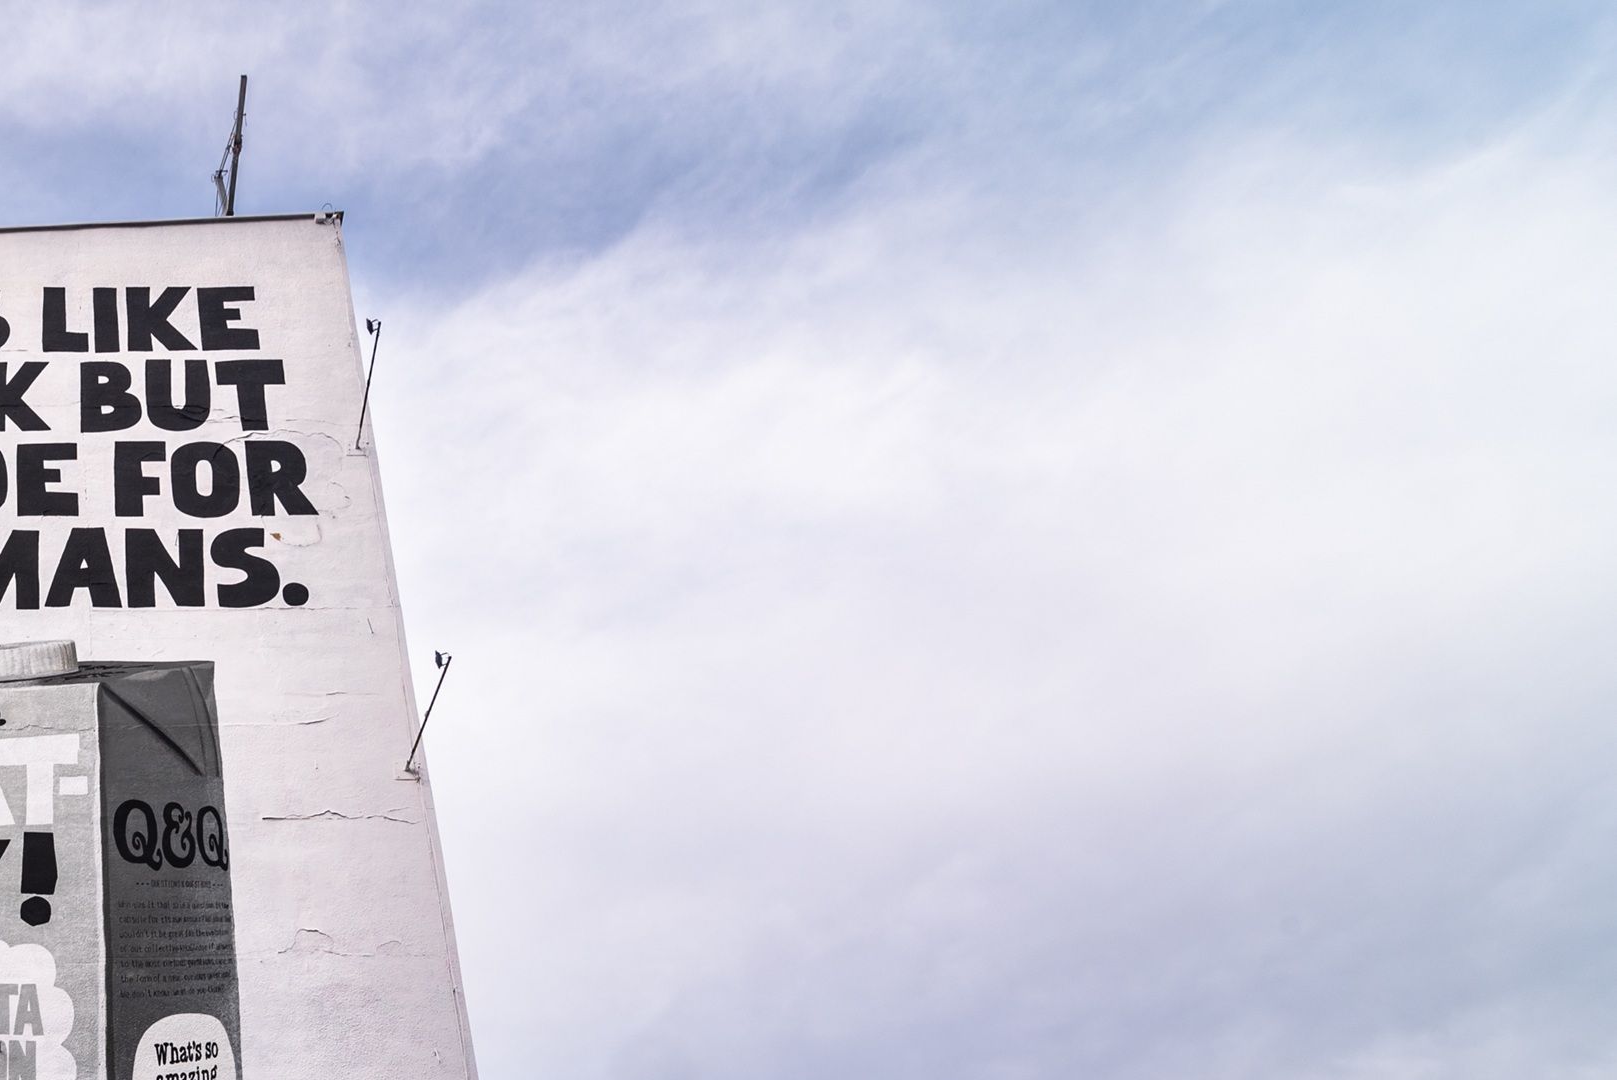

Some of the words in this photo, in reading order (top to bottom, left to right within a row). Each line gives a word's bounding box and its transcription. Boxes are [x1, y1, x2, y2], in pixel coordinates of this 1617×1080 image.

[42, 286, 260, 353] LIKE
[80, 359, 286, 433] BUT
[114, 440, 320, 519] FOR
[113, 799, 229, 871] Q&Q
[154, 1040, 202, 1066] What's
[205, 1041, 219, 1059] so
